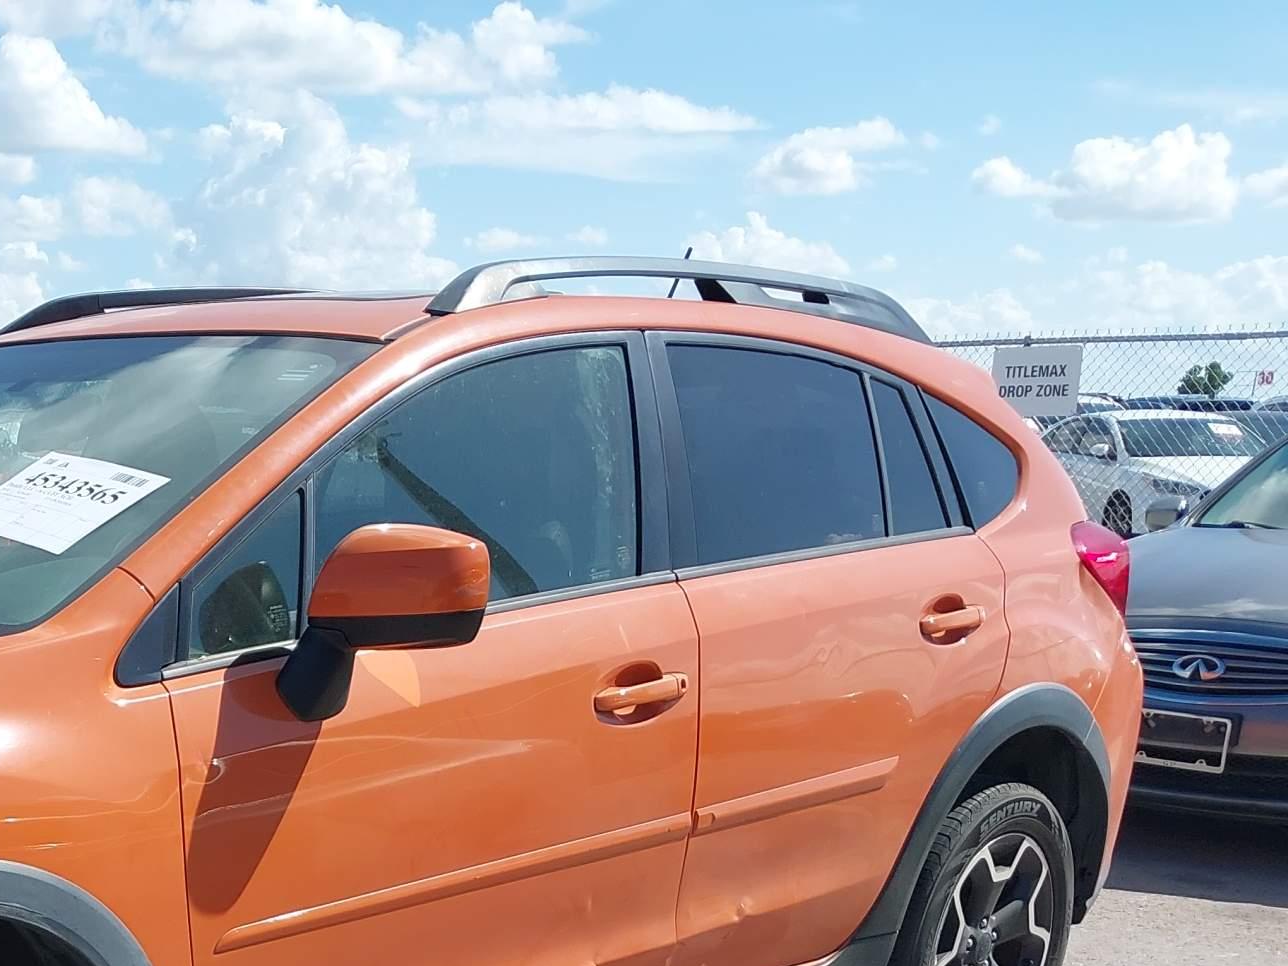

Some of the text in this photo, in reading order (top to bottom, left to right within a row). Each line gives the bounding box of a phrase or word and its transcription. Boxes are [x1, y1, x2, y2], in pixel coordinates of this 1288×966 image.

[1005, 364, 1068, 378] TITLEMAX
[1257, 371, 1274, 385] 30
[999, 384, 1070, 398] DROP ZONE
[25, 472, 128, 505] 45343565
